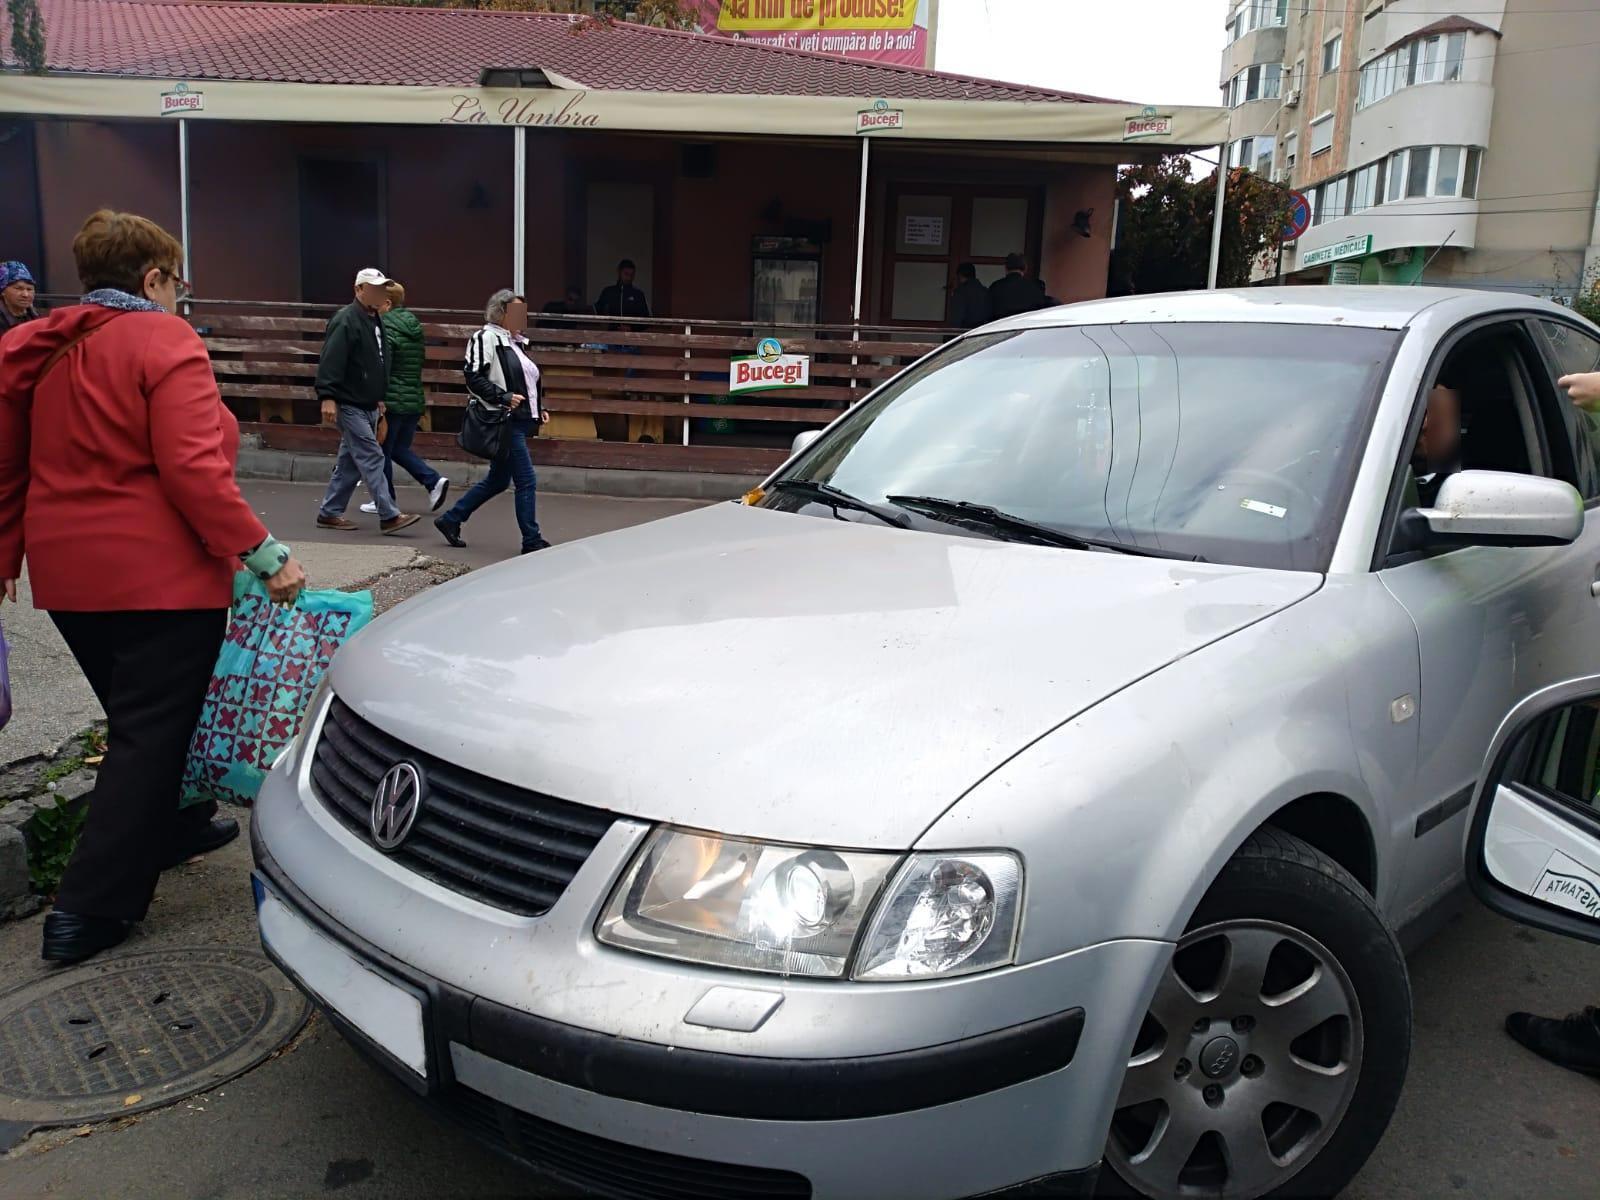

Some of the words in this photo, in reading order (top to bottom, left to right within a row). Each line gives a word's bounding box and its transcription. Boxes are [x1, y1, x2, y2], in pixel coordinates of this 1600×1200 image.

[790, 0, 815, 18] de
[818, 0, 904, 26] produse!
[822, 32, 866, 55] cumpăra
[869, 31, 881, 50] de
[884, 31, 893, 50] la
[896, 31, 917, 50] noi!
[164, 95, 200, 109] Bucegi
[440, 94, 487, 124] La
[498, 91, 600, 127] Umbra
[861, 112, 899, 128] Bucegi
[1127, 120, 1168, 134] Bucegi
[1304, 248, 1332, 265] CABINETE
[1334, 239, 1367, 257] MEDICALE
[736, 360, 803, 384] Bucegi
